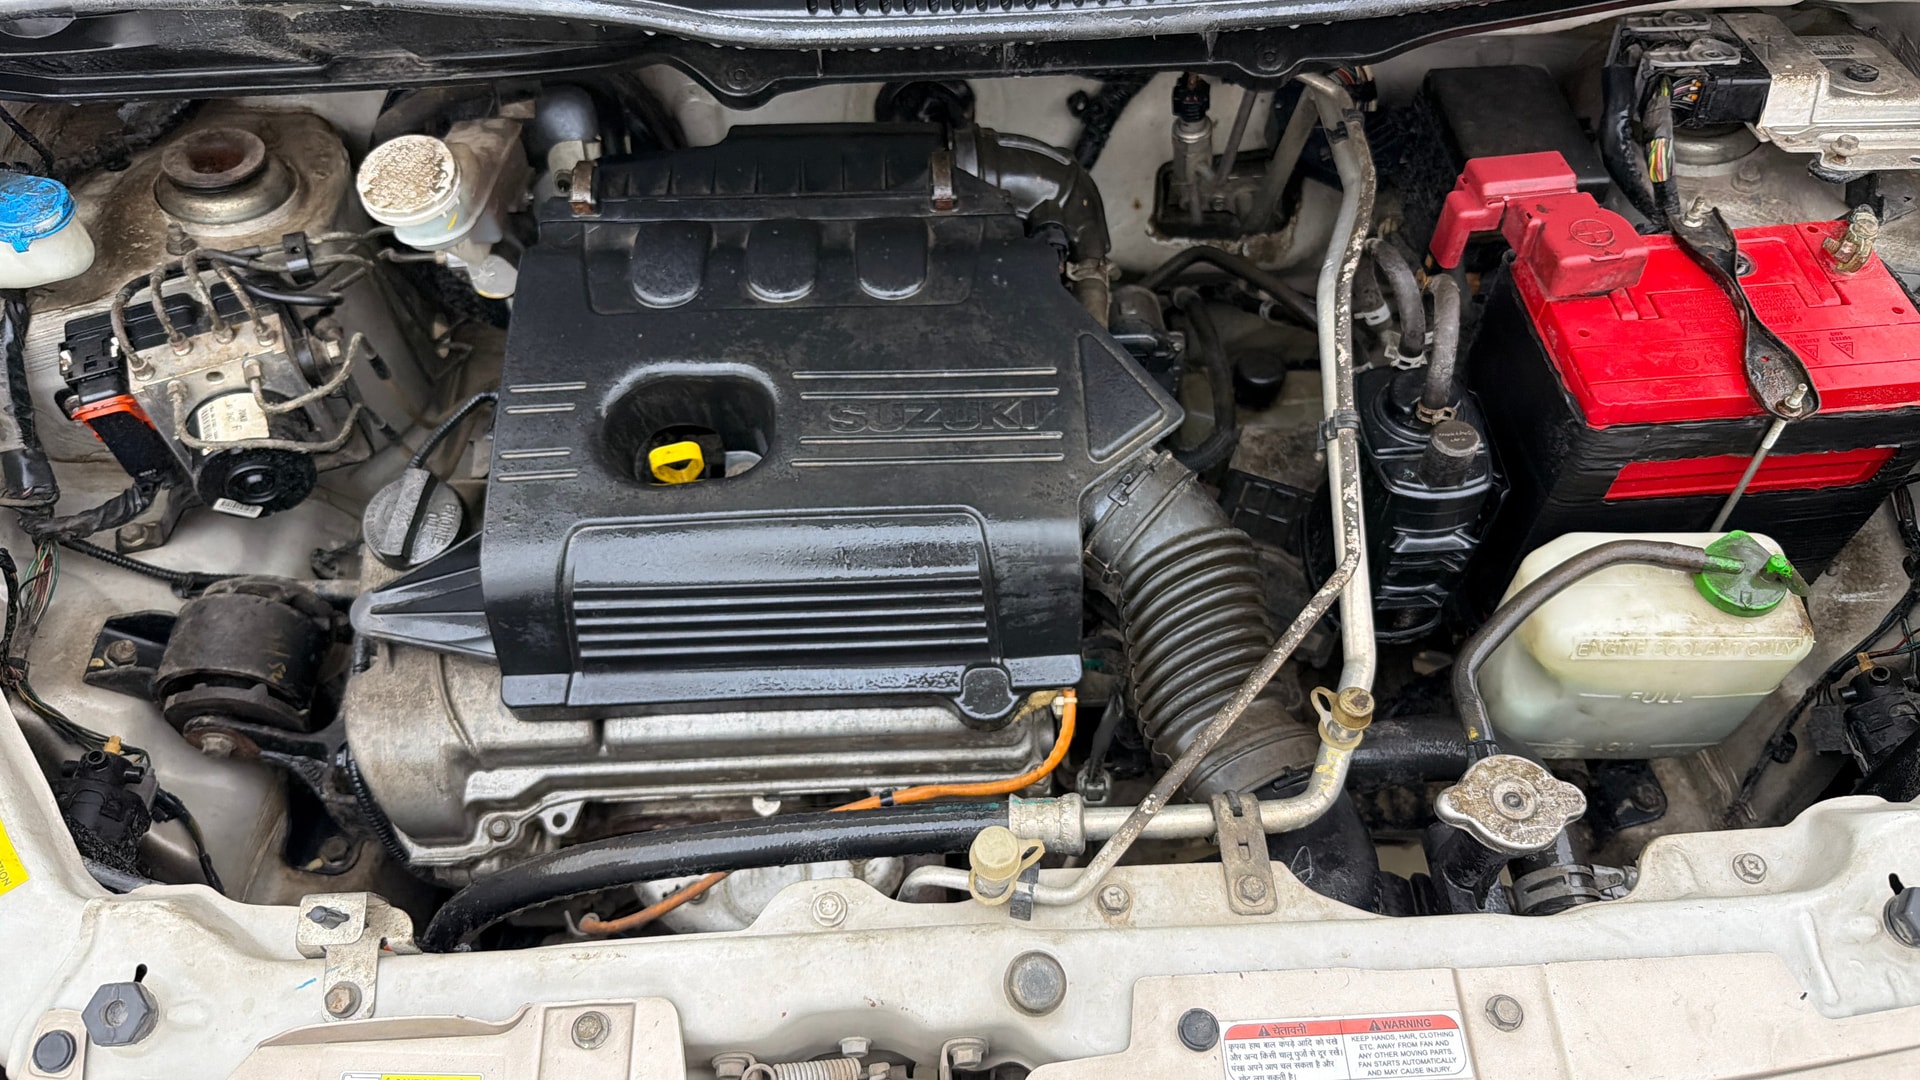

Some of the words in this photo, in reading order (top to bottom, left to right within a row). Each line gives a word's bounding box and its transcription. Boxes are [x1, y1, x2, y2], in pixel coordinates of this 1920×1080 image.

[828, 400, 1039, 433] SUZUKI
[433, 503, 458, 545] ENGINE
[1576, 641, 1646, 657] ENGINE
[1652, 641, 1740, 657] COOLANT
[1745, 641, 1796, 657] ONLY
[1628, 691, 1684, 704] FULL
[1381, 1018, 1432, 1029] WARNING
[1272, 1023, 1307, 1036] चेतावनी
[1419, 1031, 1454, 1039] CLOTHING
[1230, 1052, 1242, 1061] और
[1358, 1052, 1372, 1060] ANY
[1374, 1051, 1399, 1059] OTHER
[1400, 1049, 1428, 1057] MOVING
[1430, 1048, 1454, 1056] PARTS.
[1315, 1059, 1321, 1069] है
[1322, 1059, 1335, 1068] और
[1402, 1057, 1457, 1067] AUTOMATICALLY
[1400, 1067, 1424, 1075] CAUSE
[1426, 1065, 1452, 1073] INJURY.
